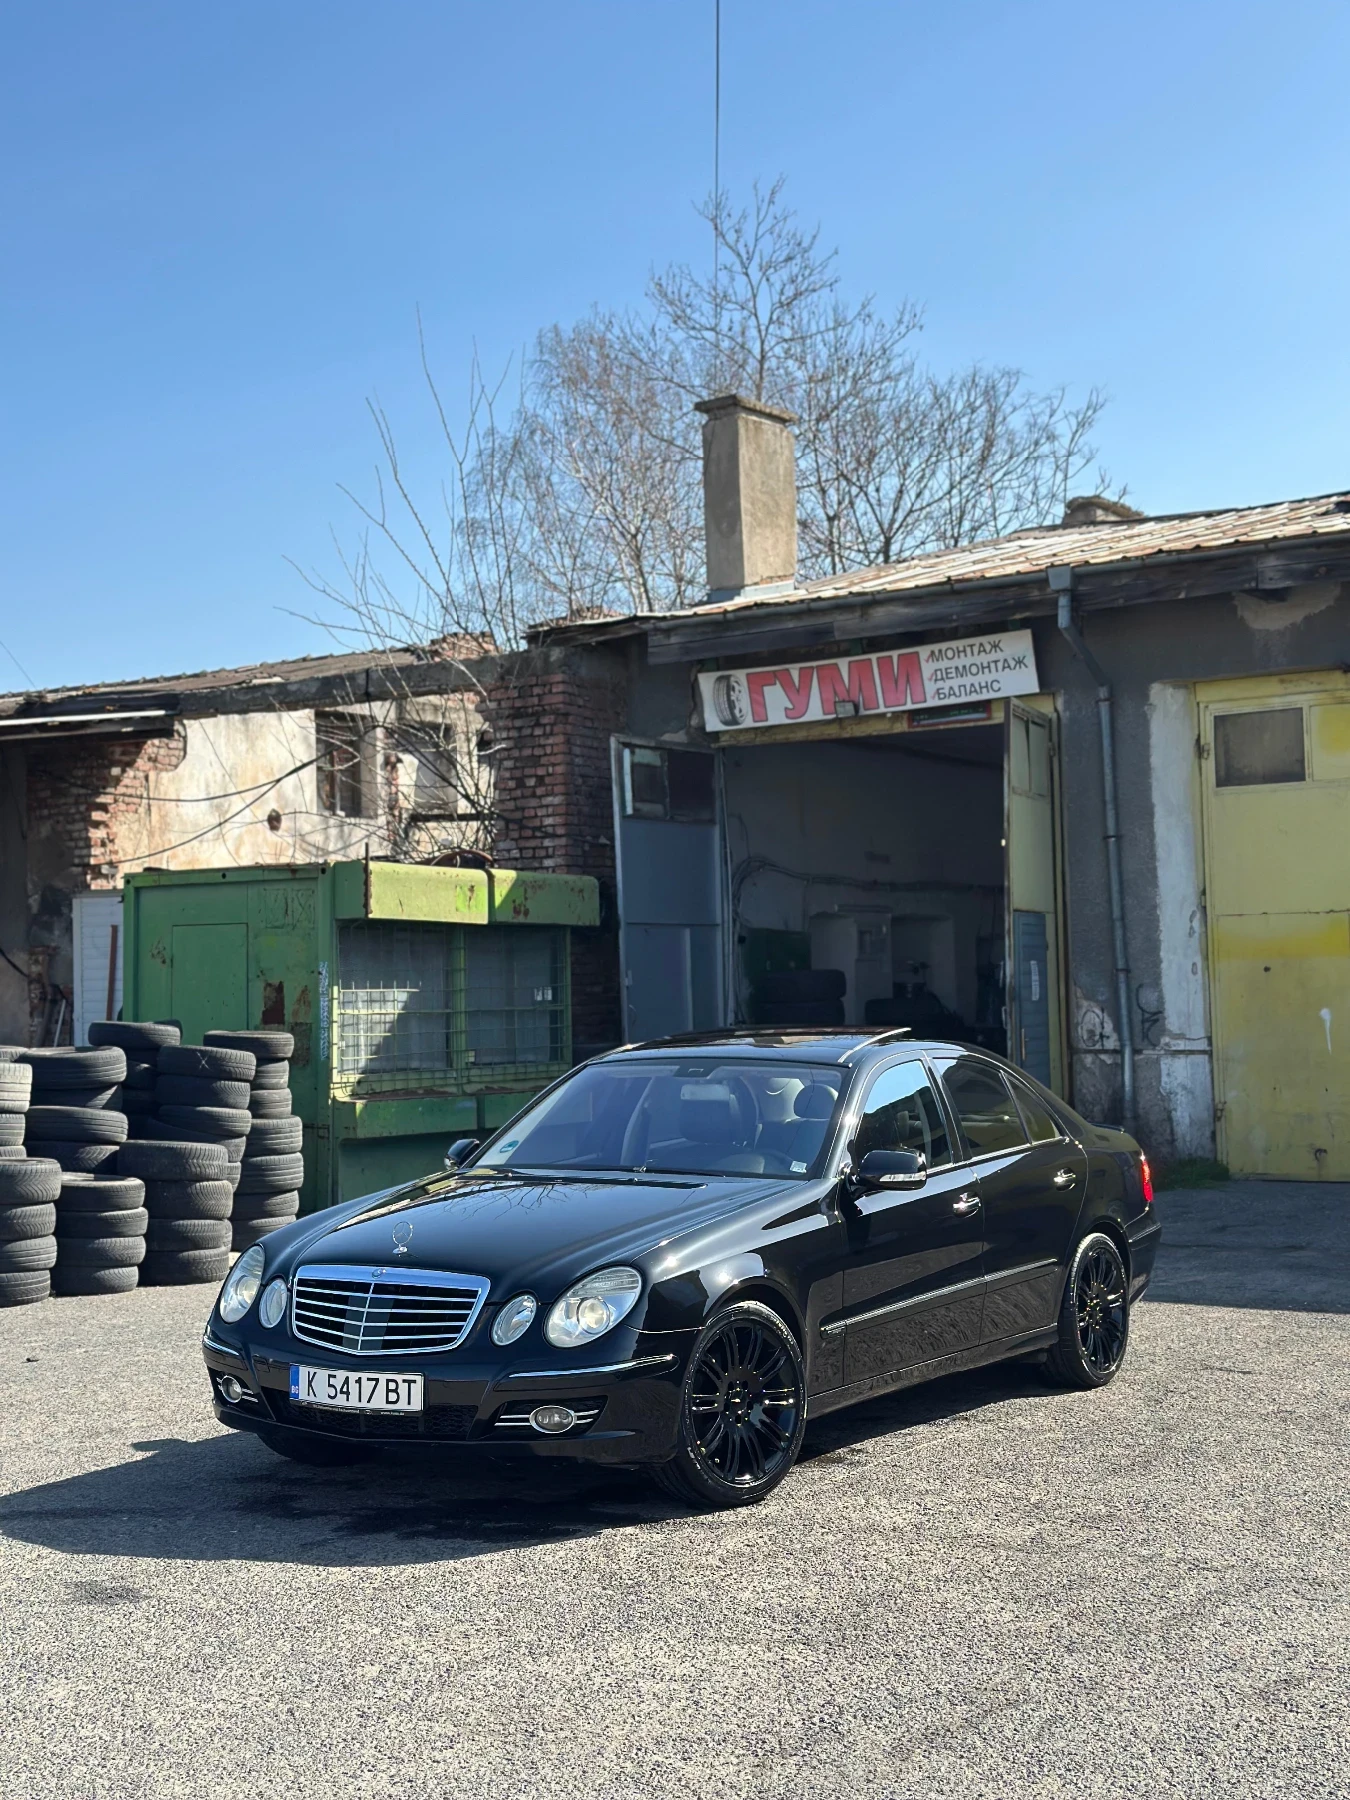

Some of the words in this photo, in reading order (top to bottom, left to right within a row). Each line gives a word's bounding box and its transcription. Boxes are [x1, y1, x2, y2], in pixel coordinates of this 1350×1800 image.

[931, 640, 1004, 663] МОНТАЖ
[933, 656, 1029, 684] ДЕМОНТАЖ
[746, 651, 927, 722] ГУМИ
[936, 679, 1002, 701] БАЛАНС
